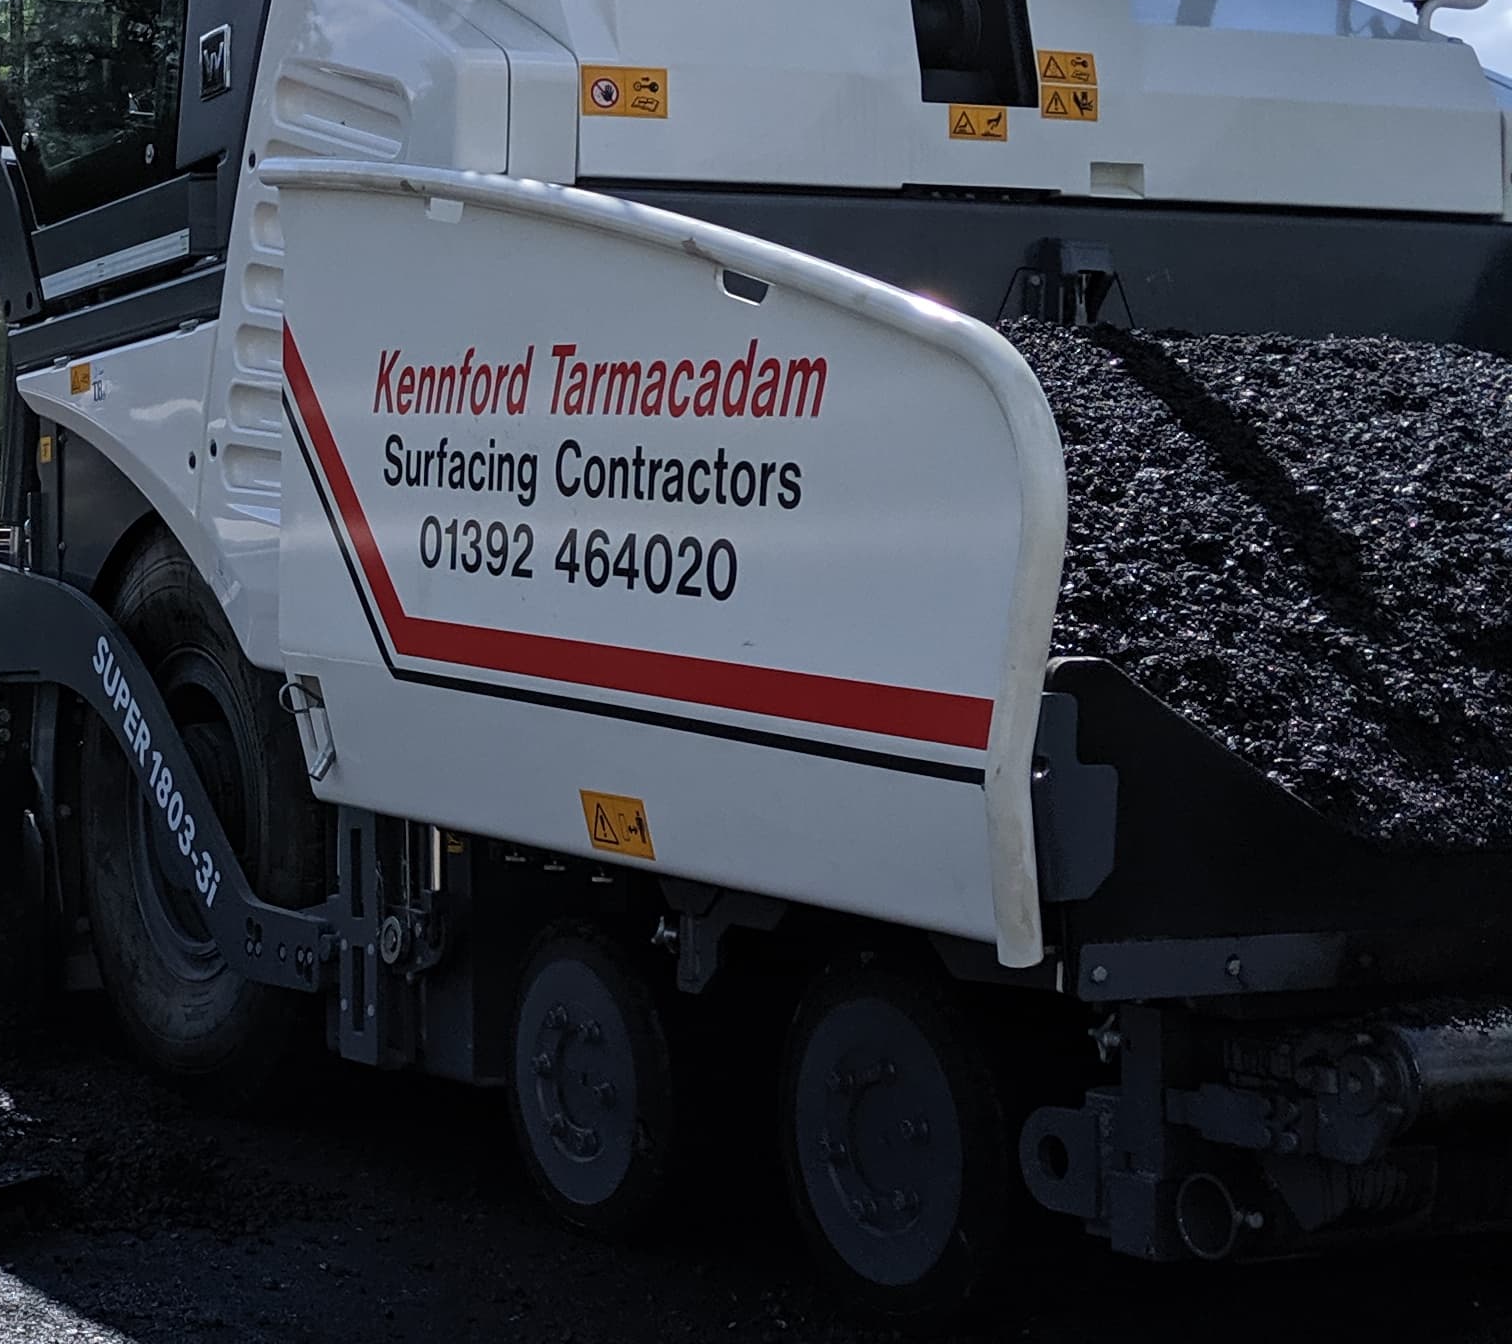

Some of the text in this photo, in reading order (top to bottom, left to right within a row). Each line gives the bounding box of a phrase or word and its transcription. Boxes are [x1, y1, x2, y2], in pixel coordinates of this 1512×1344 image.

[373, 339, 828, 418] Kennford Tarmacadam
[384, 434, 802, 509] Surfacing Contractors
[420, 515, 738, 601] 01392 464020
[92, 635, 221, 908] SUPER 1803-3i
